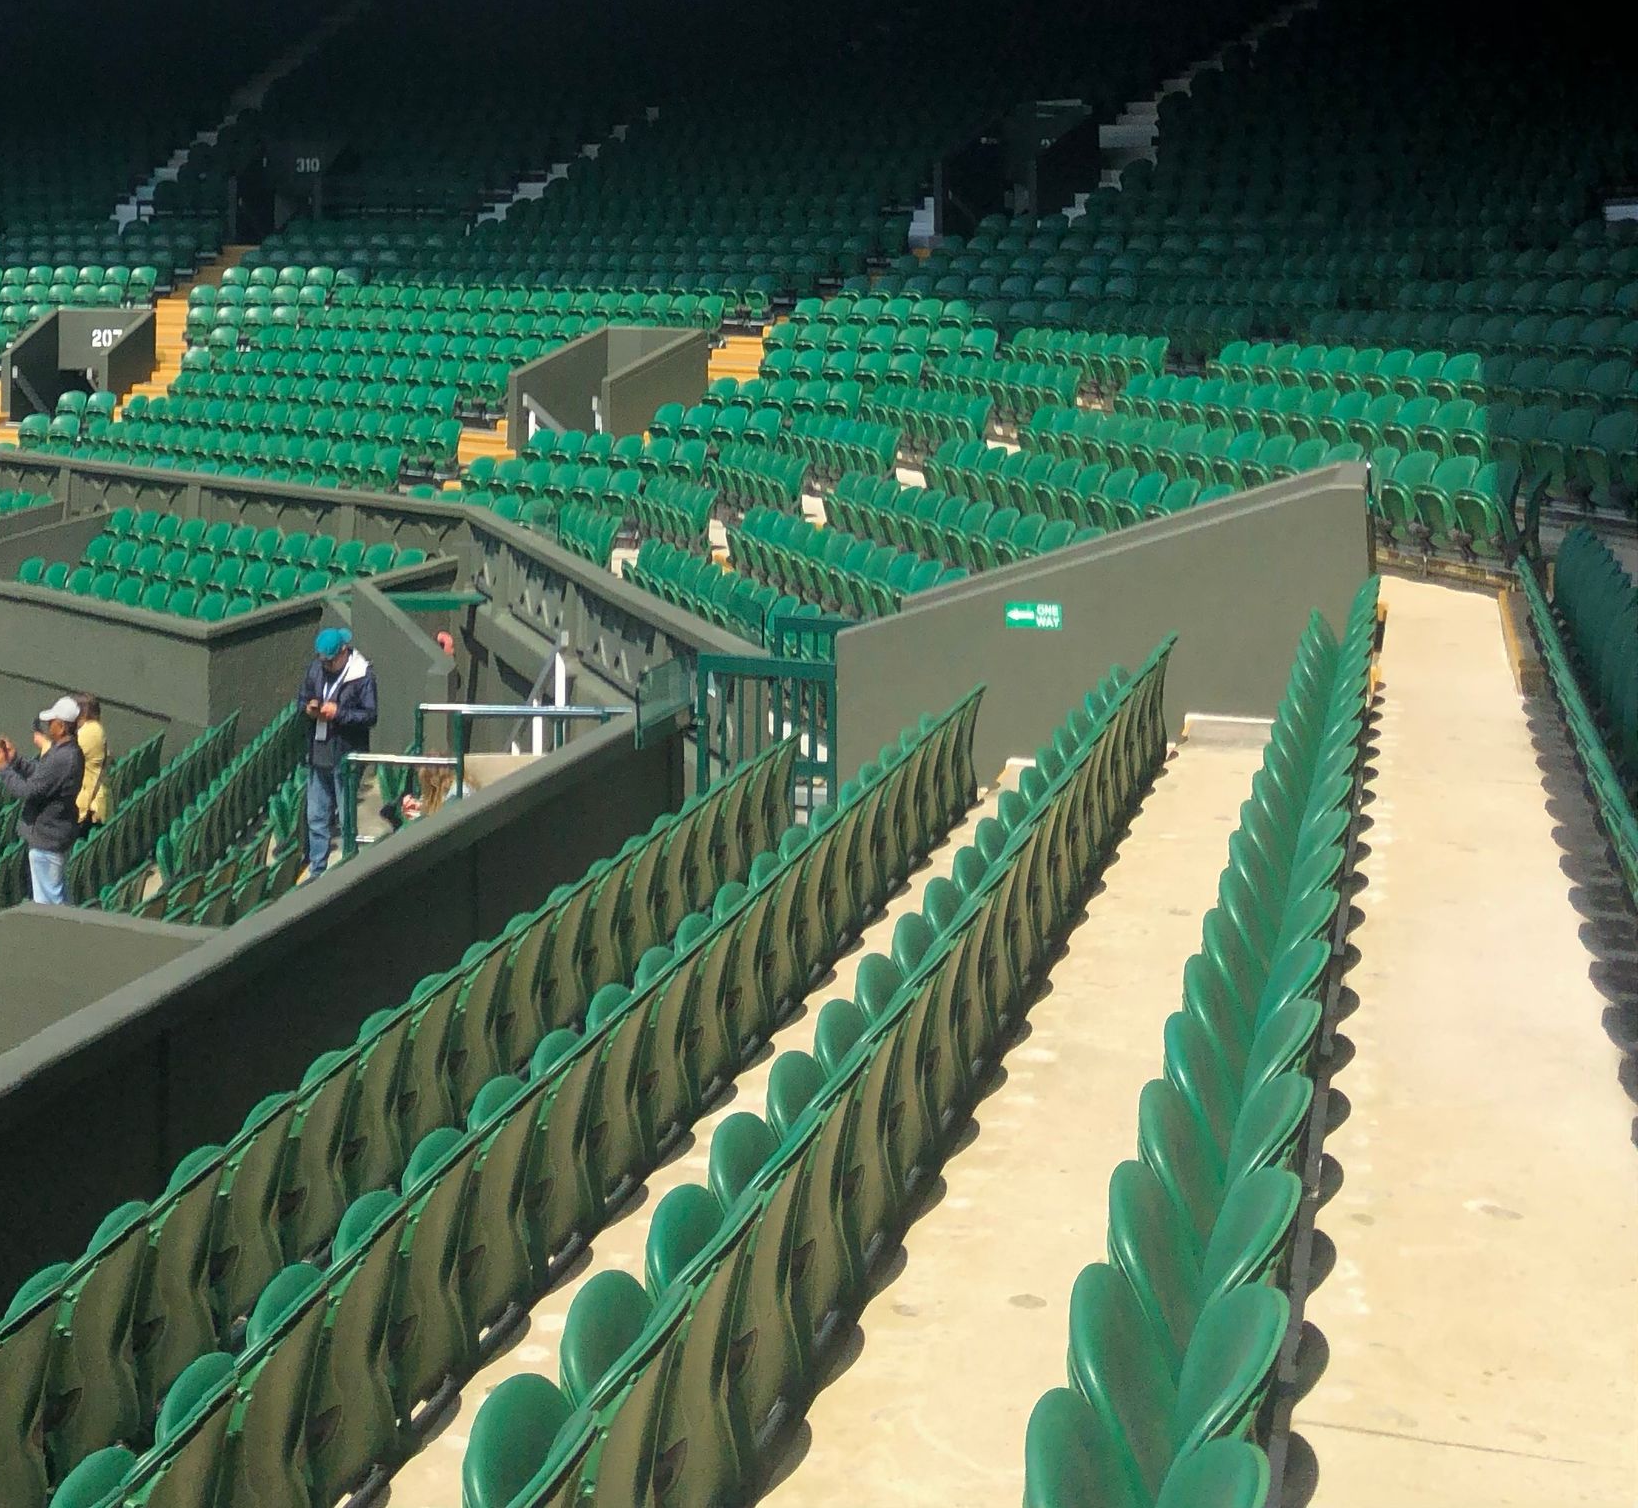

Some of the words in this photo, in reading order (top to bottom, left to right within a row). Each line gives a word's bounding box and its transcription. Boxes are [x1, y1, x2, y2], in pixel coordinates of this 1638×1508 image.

[296, 157, 319, 172] 310
[92, 329, 122, 347] 207
[1037, 603, 1059, 616] ONE
[1036, 615, 1060, 628] WAY
